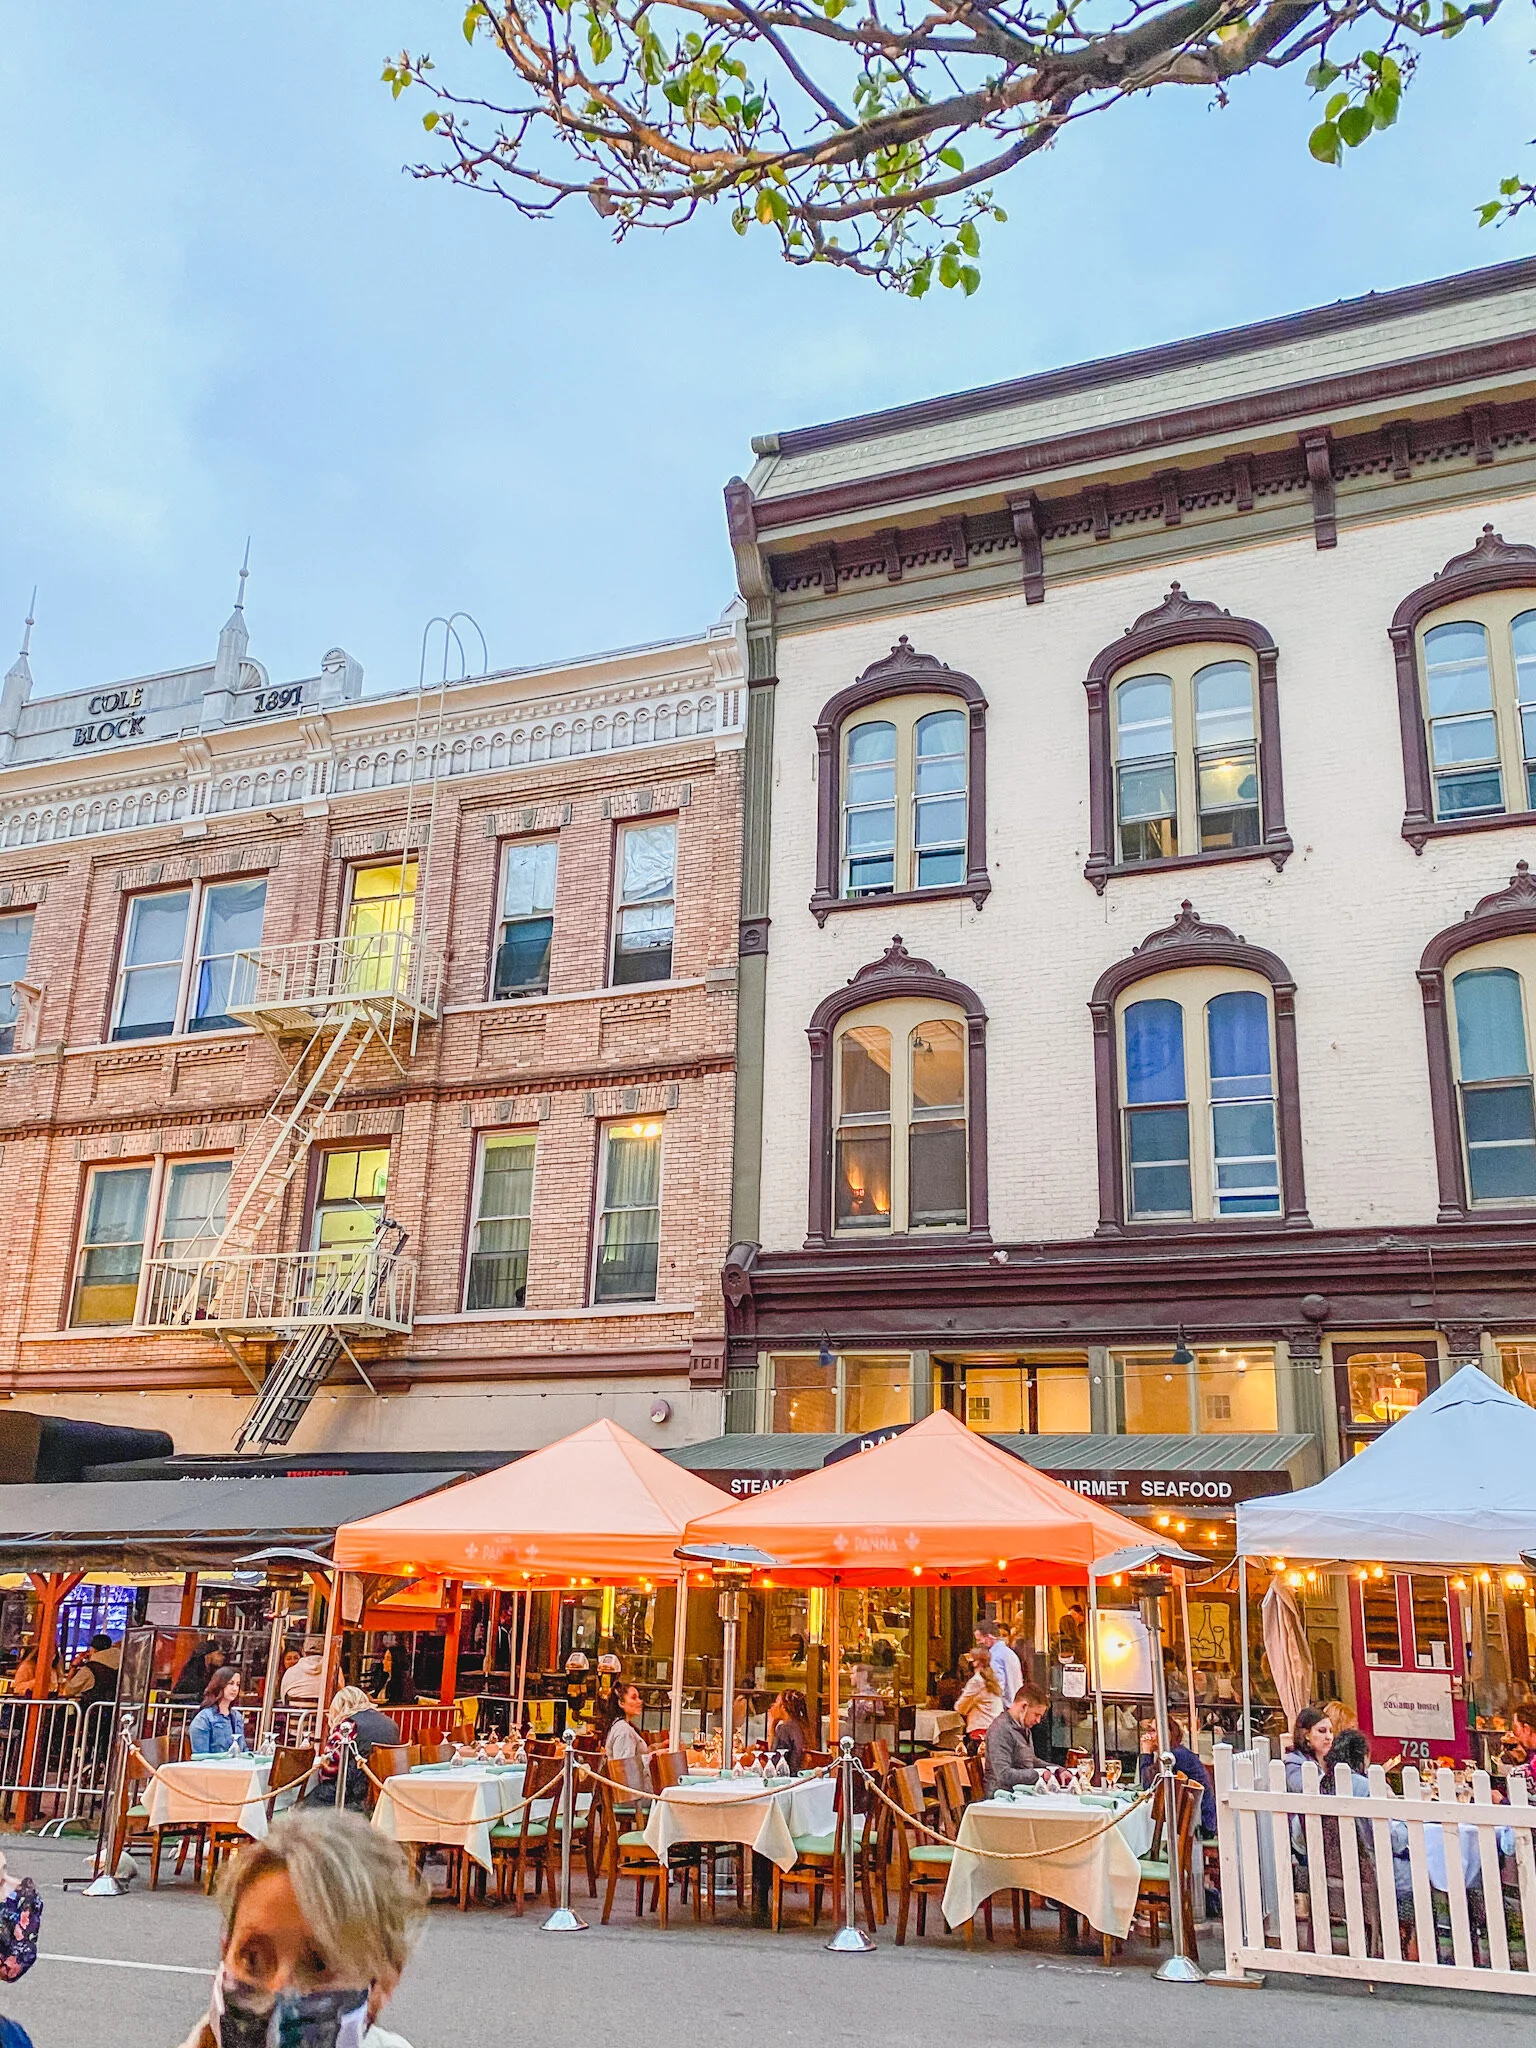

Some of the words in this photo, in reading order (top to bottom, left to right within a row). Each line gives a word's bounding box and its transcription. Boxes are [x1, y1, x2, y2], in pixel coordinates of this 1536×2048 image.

[88, 688, 144, 715] COLE
[253, 686, 303, 713] 1891
[72, 715, 146, 747] BLOCK
[730, 1478, 793, 1494] STEAK
[1057, 1480, 1130, 1496] URMET
[1141, 1480, 1233, 1498] SEAFOOD
[1400, 1740, 1430, 1758] 726
